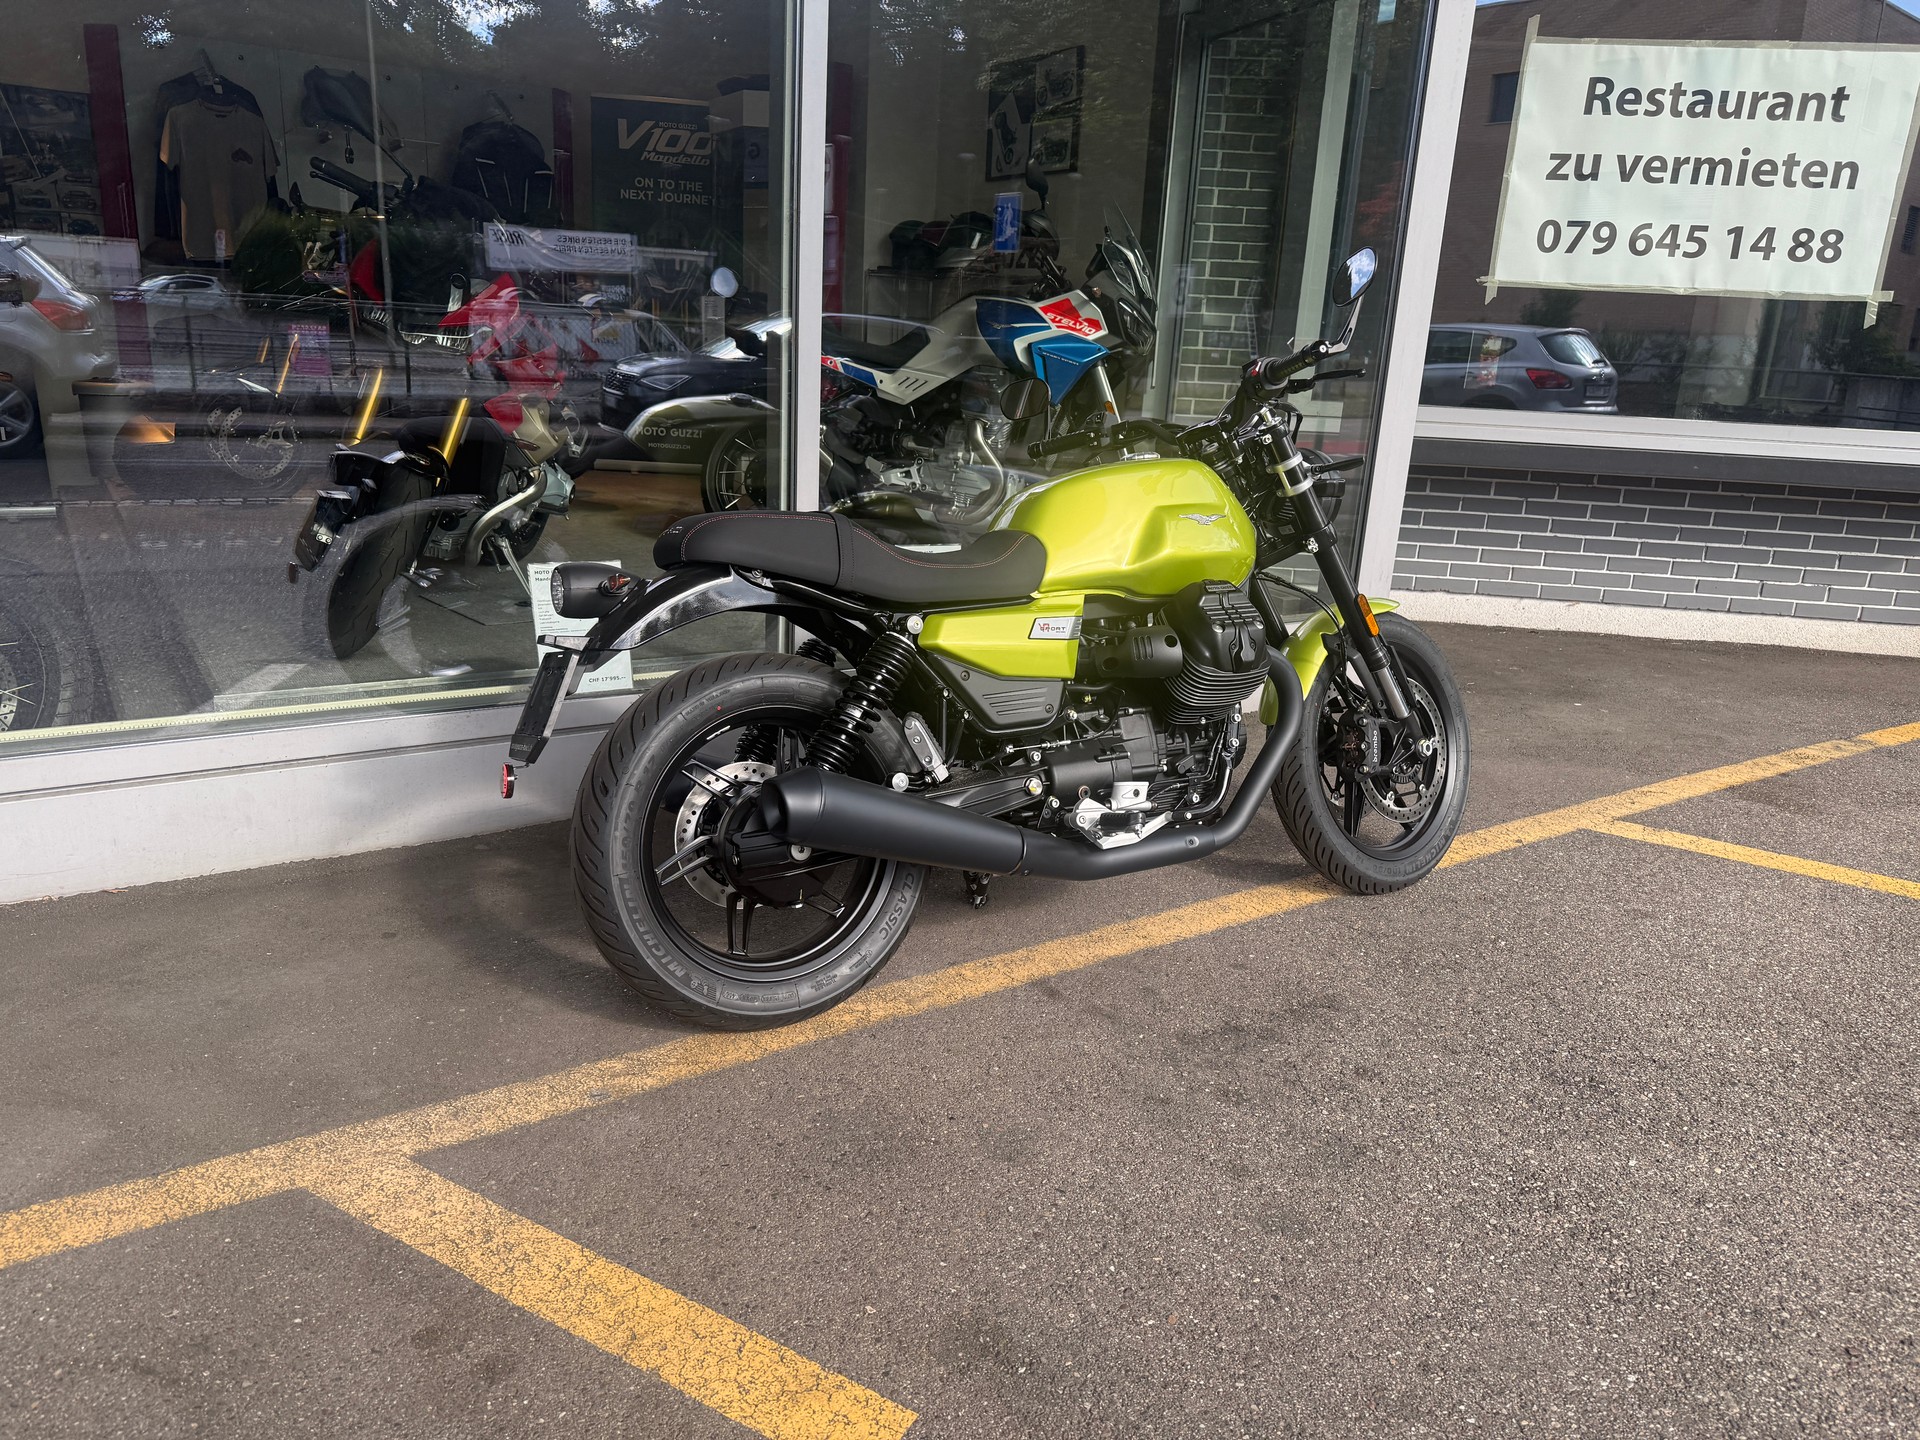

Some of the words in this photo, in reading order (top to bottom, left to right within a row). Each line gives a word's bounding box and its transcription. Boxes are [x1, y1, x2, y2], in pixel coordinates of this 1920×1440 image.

[1583, 76, 1850, 122] Restaurant
[617, 118, 715, 156] V100
[659, 121, 678, 129] MOTO
[640, 151, 710, 166] Mandello
[1545, 153, 1602, 182] zu
[1616, 147, 1860, 190] vermieten
[620, 189, 655, 201] NEXT
[634, 177, 654, 187] ON
[657, 179, 675, 189] TO
[679, 181, 703, 192] THE
[1536, 219, 1618, 255] 079
[1628, 222, 1709, 259] 645
[1726, 226, 1777, 261] 14
[1787, 227, 1844, 263] 88
[1046, 312, 1096, 335] STELVIO
[636, 426, 666, 436] MOTO
[670, 428, 703, 438] GUZZI
[1404, 836, 1445, 874] MICHELIN
[879, 873, 915, 941] CLASSIC
[623, 884, 688, 978] MICHELIN
